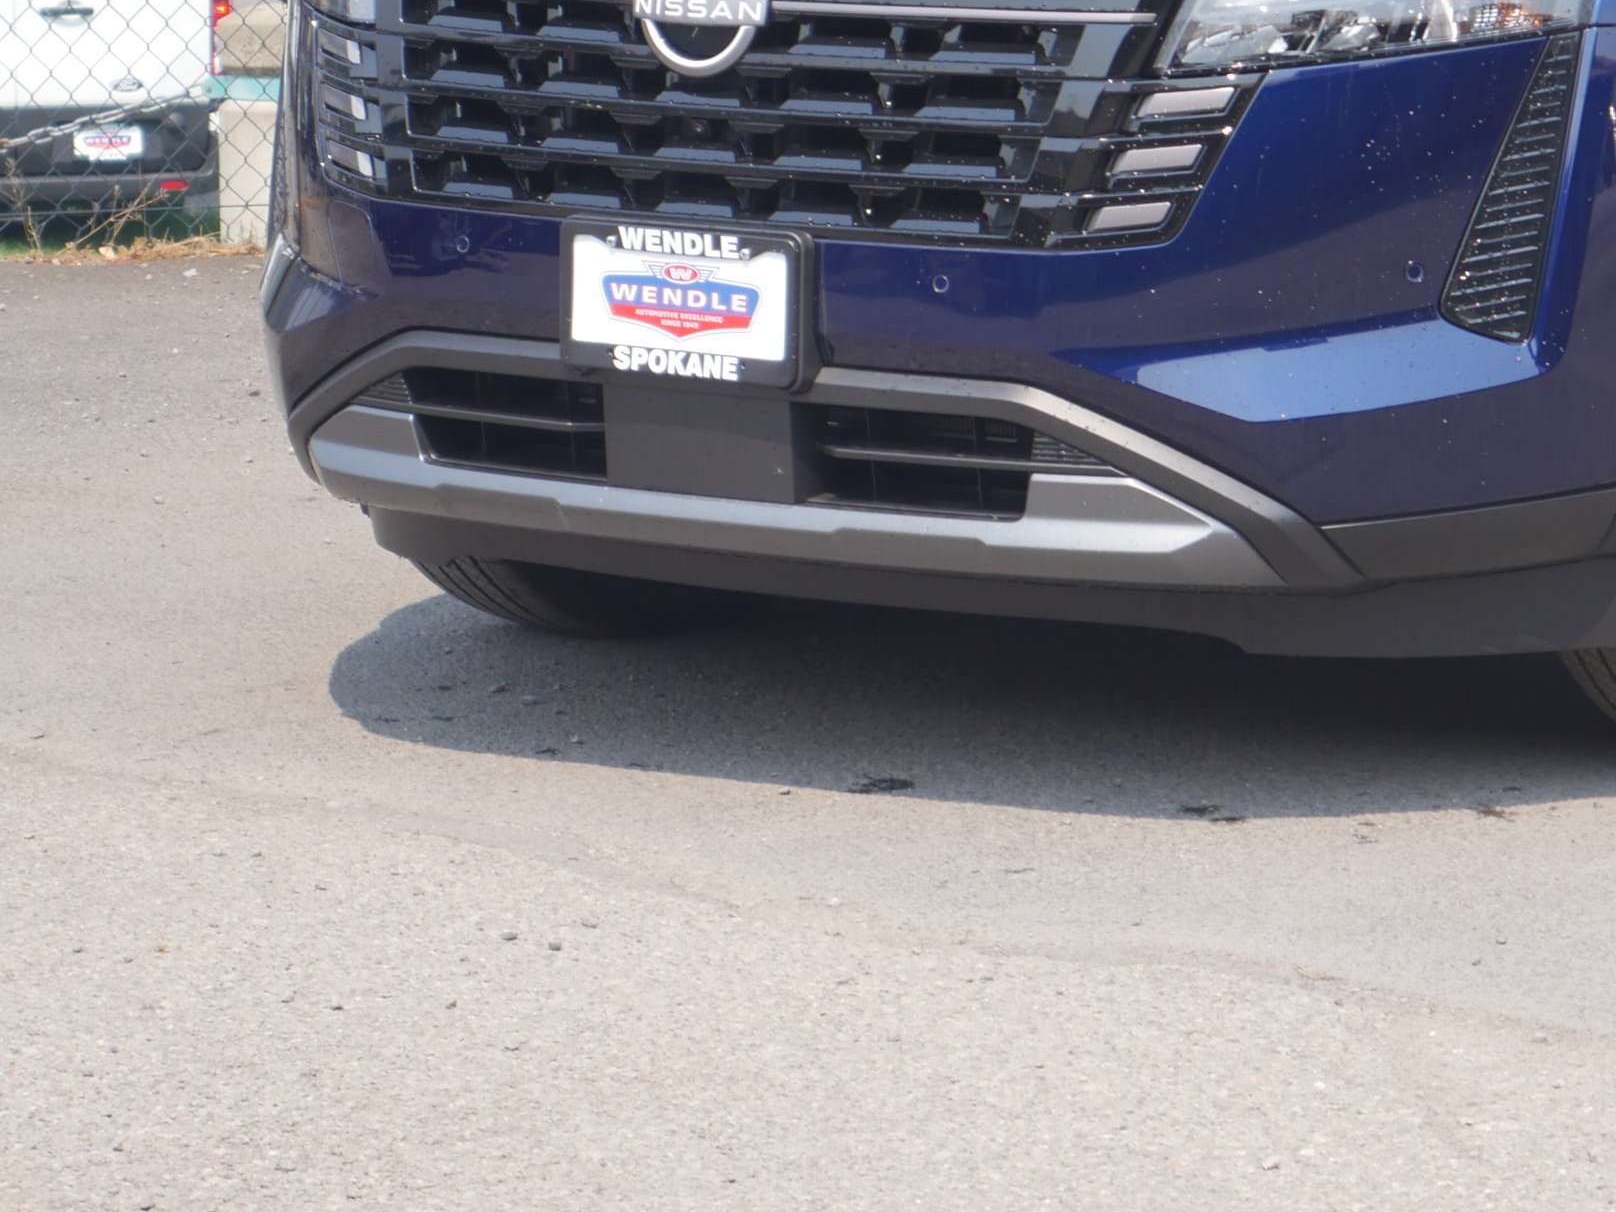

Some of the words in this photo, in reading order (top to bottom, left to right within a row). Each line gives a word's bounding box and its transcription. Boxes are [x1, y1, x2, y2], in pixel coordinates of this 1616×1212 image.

[617, 225, 739, 260] WENDLE
[609, 282, 748, 313] WENDLE
[612, 345, 739, 381] SPOKANE
